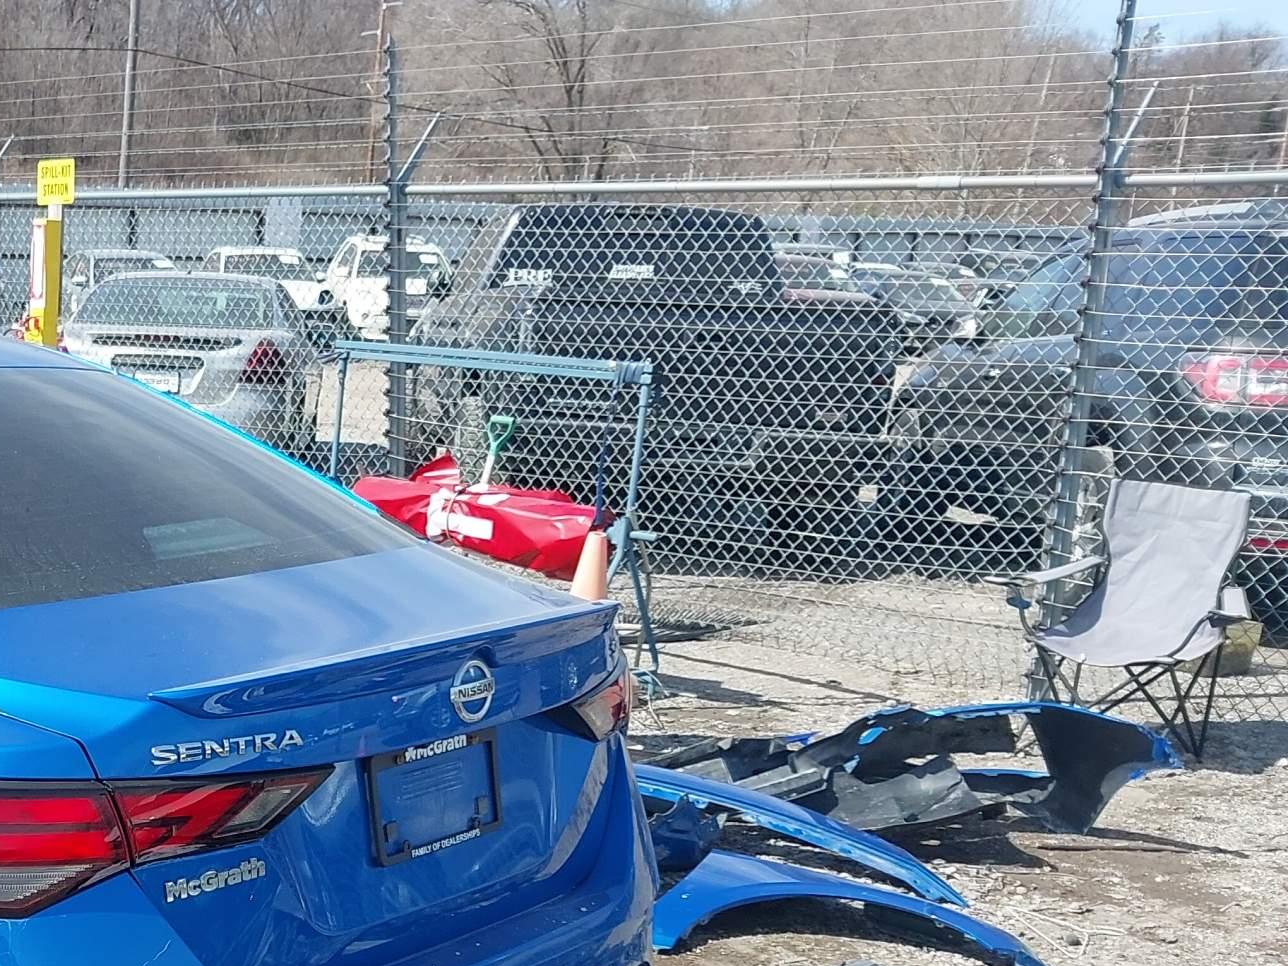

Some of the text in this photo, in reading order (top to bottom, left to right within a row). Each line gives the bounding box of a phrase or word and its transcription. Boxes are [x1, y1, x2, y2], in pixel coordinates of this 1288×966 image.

[41, 165, 71, 179] SPILL-KIT
[43, 183, 69, 197] STATION
[458, 682, 493, 699] NISSAN
[150, 729, 304, 766] SENTRA
[411, 828, 481, 858] FAMILY OF DEALERSHIPS
[165, 857, 266, 903] McGrath
